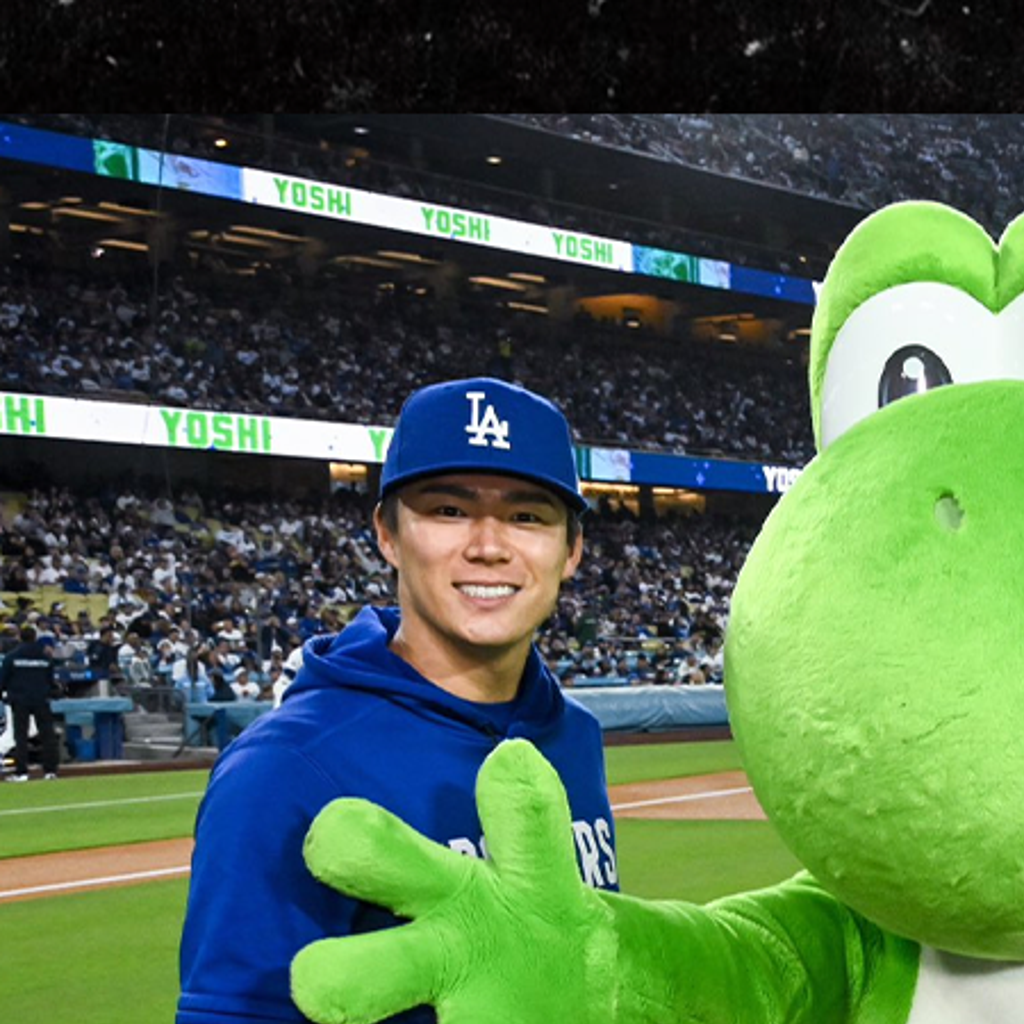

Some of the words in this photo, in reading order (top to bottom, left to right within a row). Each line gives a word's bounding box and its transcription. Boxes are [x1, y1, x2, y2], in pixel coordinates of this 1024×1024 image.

[273, 177, 352, 217] YOSHI
[421, 206, 491, 242] YOSHI
[552, 231, 613, 264] YOSHI
[0, 394, 46, 433] HI
[159, 408, 272, 451] YOSHI
[465, 391, 511, 450] LA
